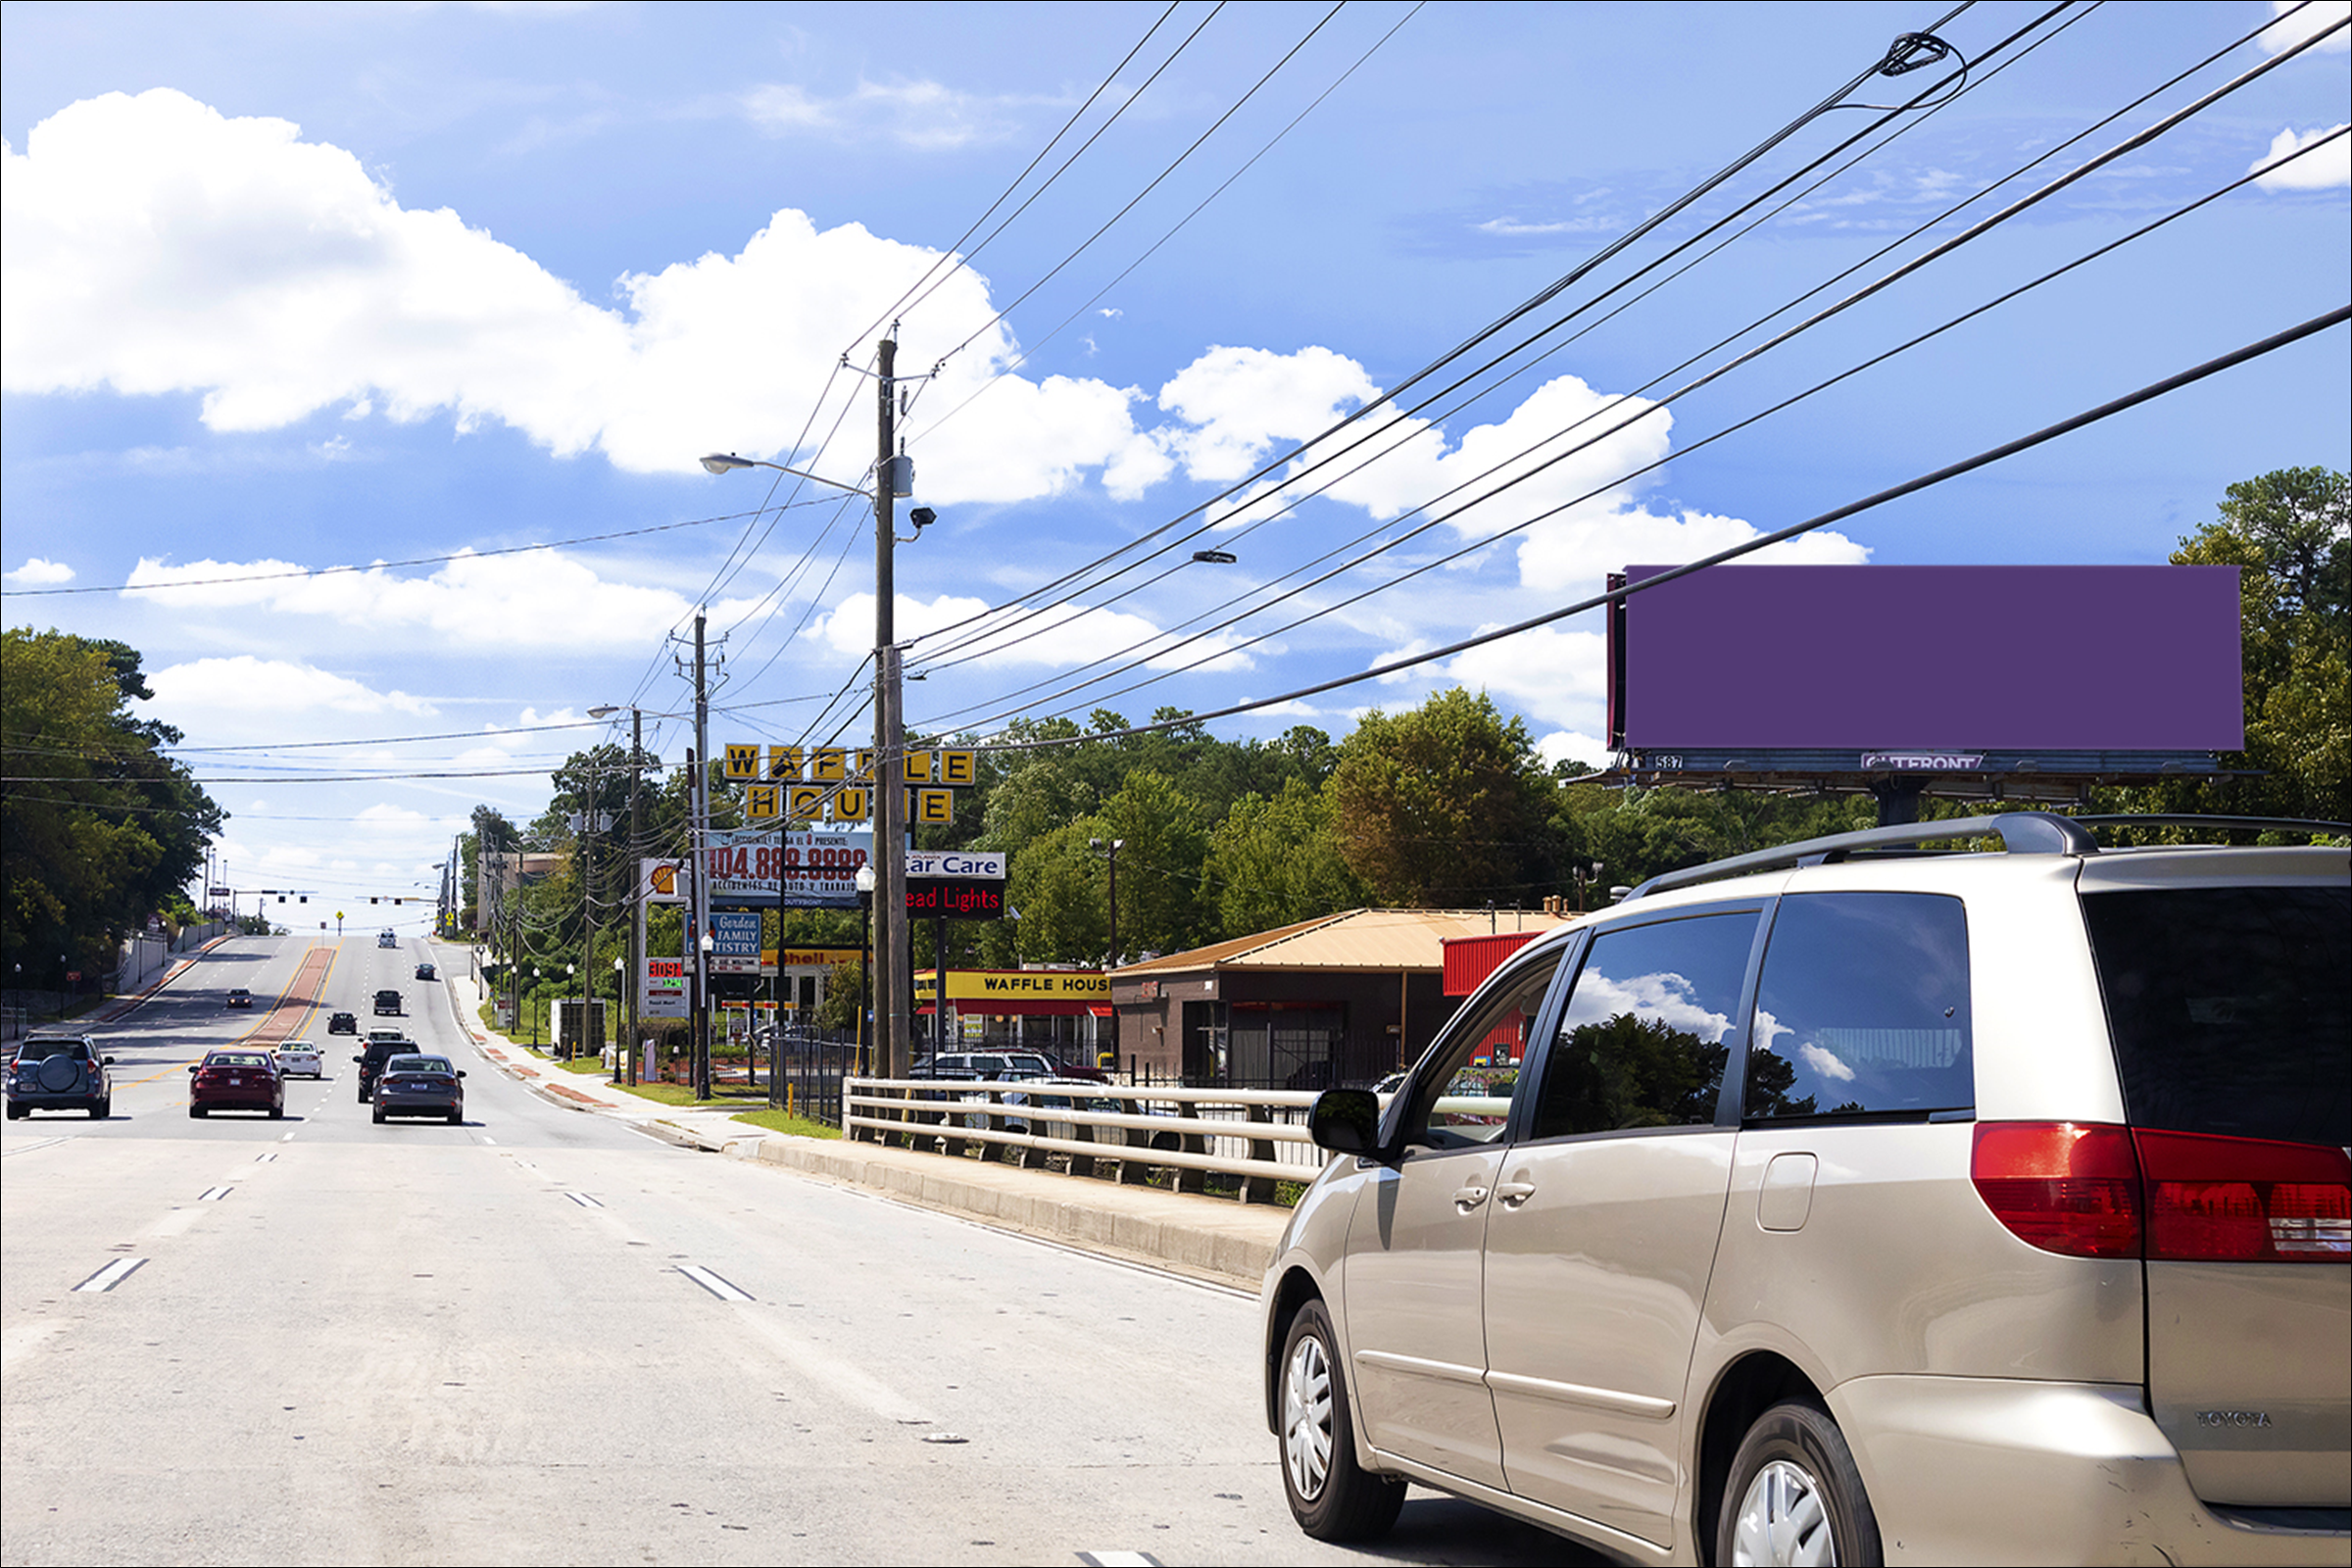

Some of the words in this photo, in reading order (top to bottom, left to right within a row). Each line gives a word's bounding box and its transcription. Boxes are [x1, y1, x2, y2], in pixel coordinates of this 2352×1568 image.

[1866, 756, 1977, 768] OTFRONT
[753, 790, 946, 818] HOUE
[807, 833, 812, 845] 8
[906, 857, 935, 872] ar
[943, 857, 998, 873] Care
[944, 887, 999, 912] Lights
[717, 931, 758, 941] FAMILY
[689, 942, 758, 953] DTISTRY
[984, 978, 1054, 991] WAFFLE
[1062, 979, 1112, 992] HOUS
[2195, 1411, 2272, 1427] TOYOTA
